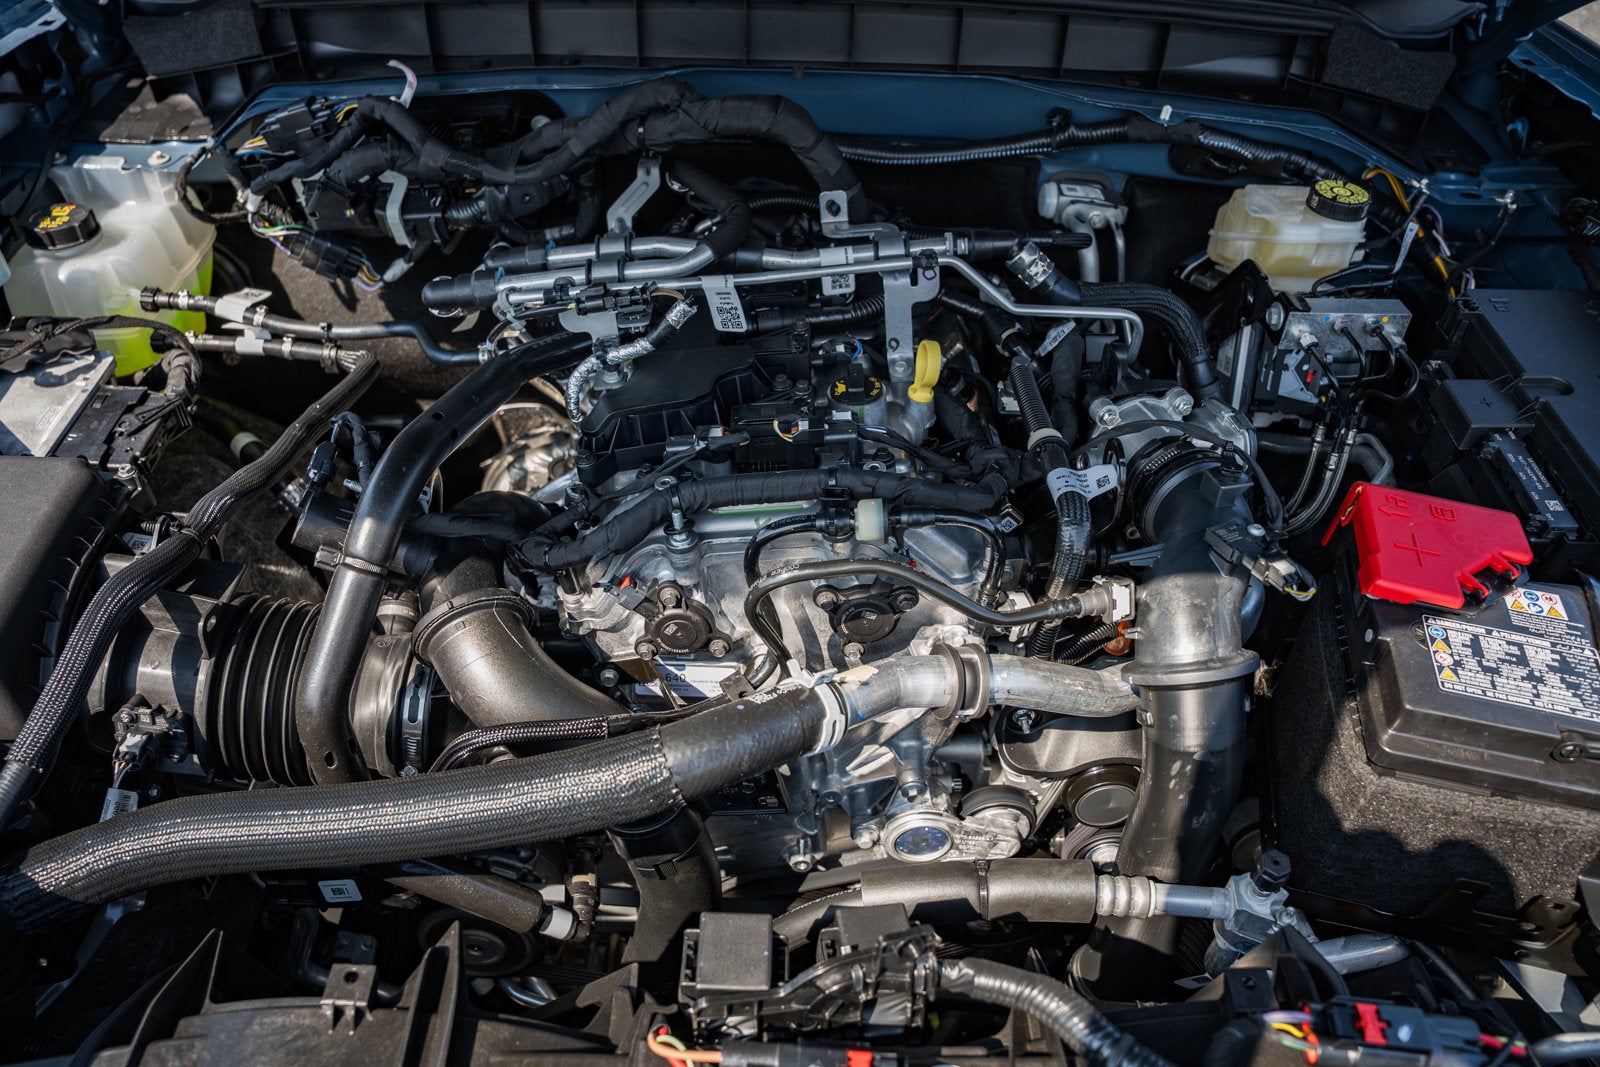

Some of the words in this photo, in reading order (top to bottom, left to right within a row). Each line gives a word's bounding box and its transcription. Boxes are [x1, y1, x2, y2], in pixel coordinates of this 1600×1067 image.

[1435, 619, 1487, 634] DANGER/POISON
[1499, 632, 1551, 648] PELIGRO/VENENO
[665, 673, 687, 683] 640
[1453, 683, 1466, 691] NOT
